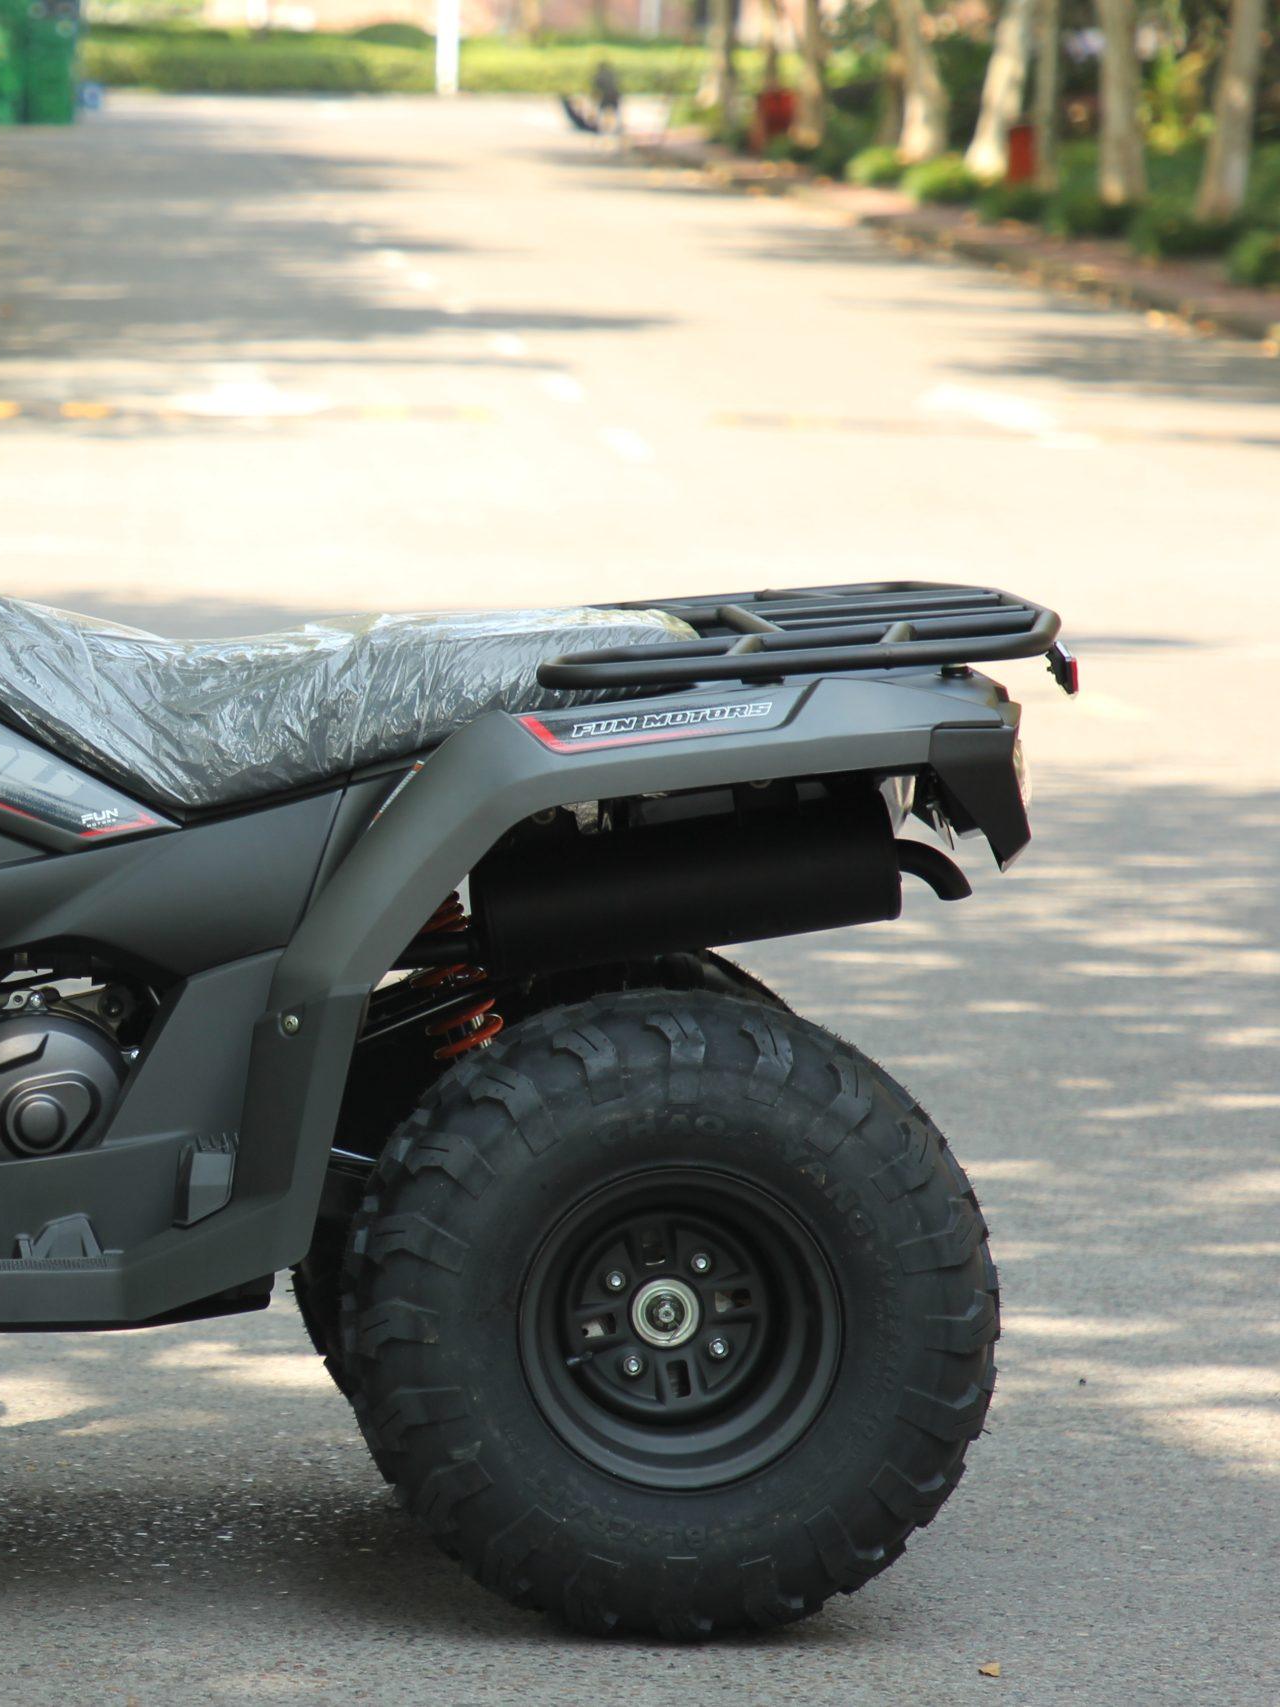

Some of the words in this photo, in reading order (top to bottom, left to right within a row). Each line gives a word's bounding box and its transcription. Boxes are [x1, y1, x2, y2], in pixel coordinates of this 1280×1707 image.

[571, 716, 638, 738] FUN
[642, 702, 773, 729] MOTORS
[80, 807, 119, 825] FUN
[598, 1110, 727, 1147] CHAO
[782, 1143, 876, 1238] YANG
